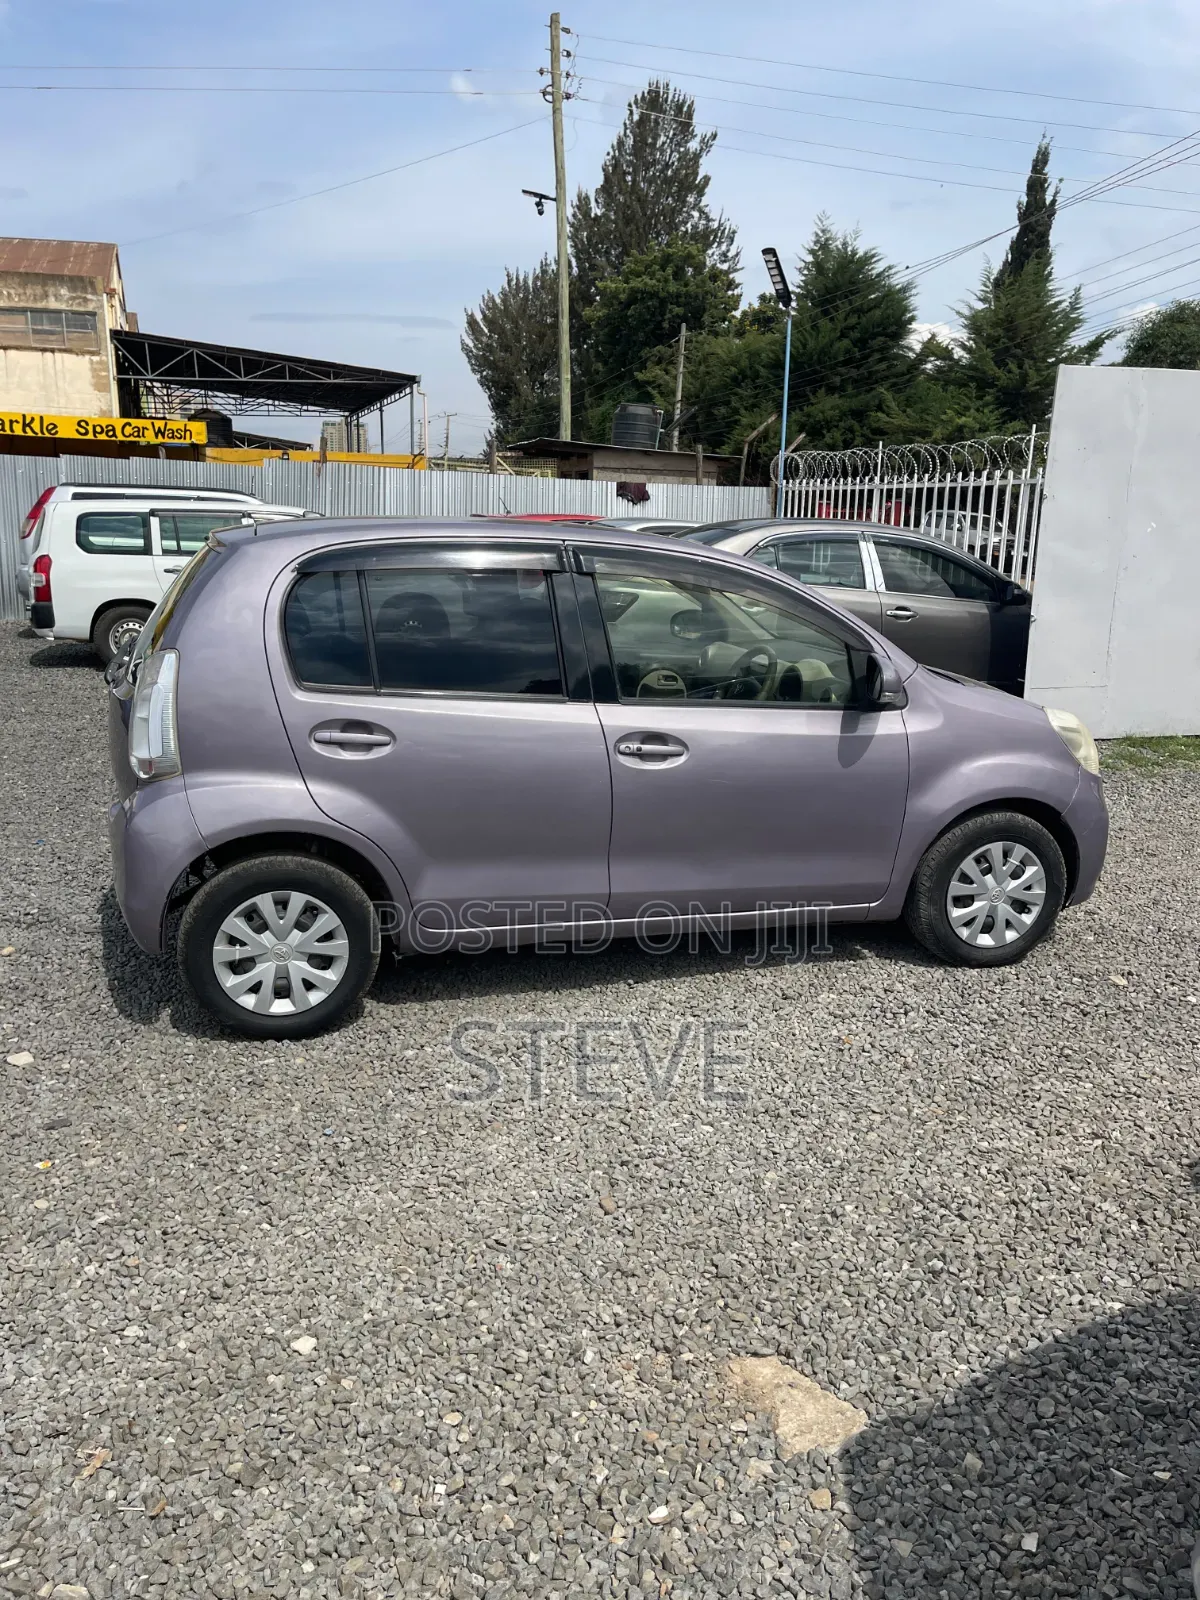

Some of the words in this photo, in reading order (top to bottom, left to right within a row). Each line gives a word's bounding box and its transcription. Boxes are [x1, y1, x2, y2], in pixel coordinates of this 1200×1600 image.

[75, 419, 118, 439] Spa
[121, 421, 150, 439] Car
[151, 421, 193, 440] Wash
